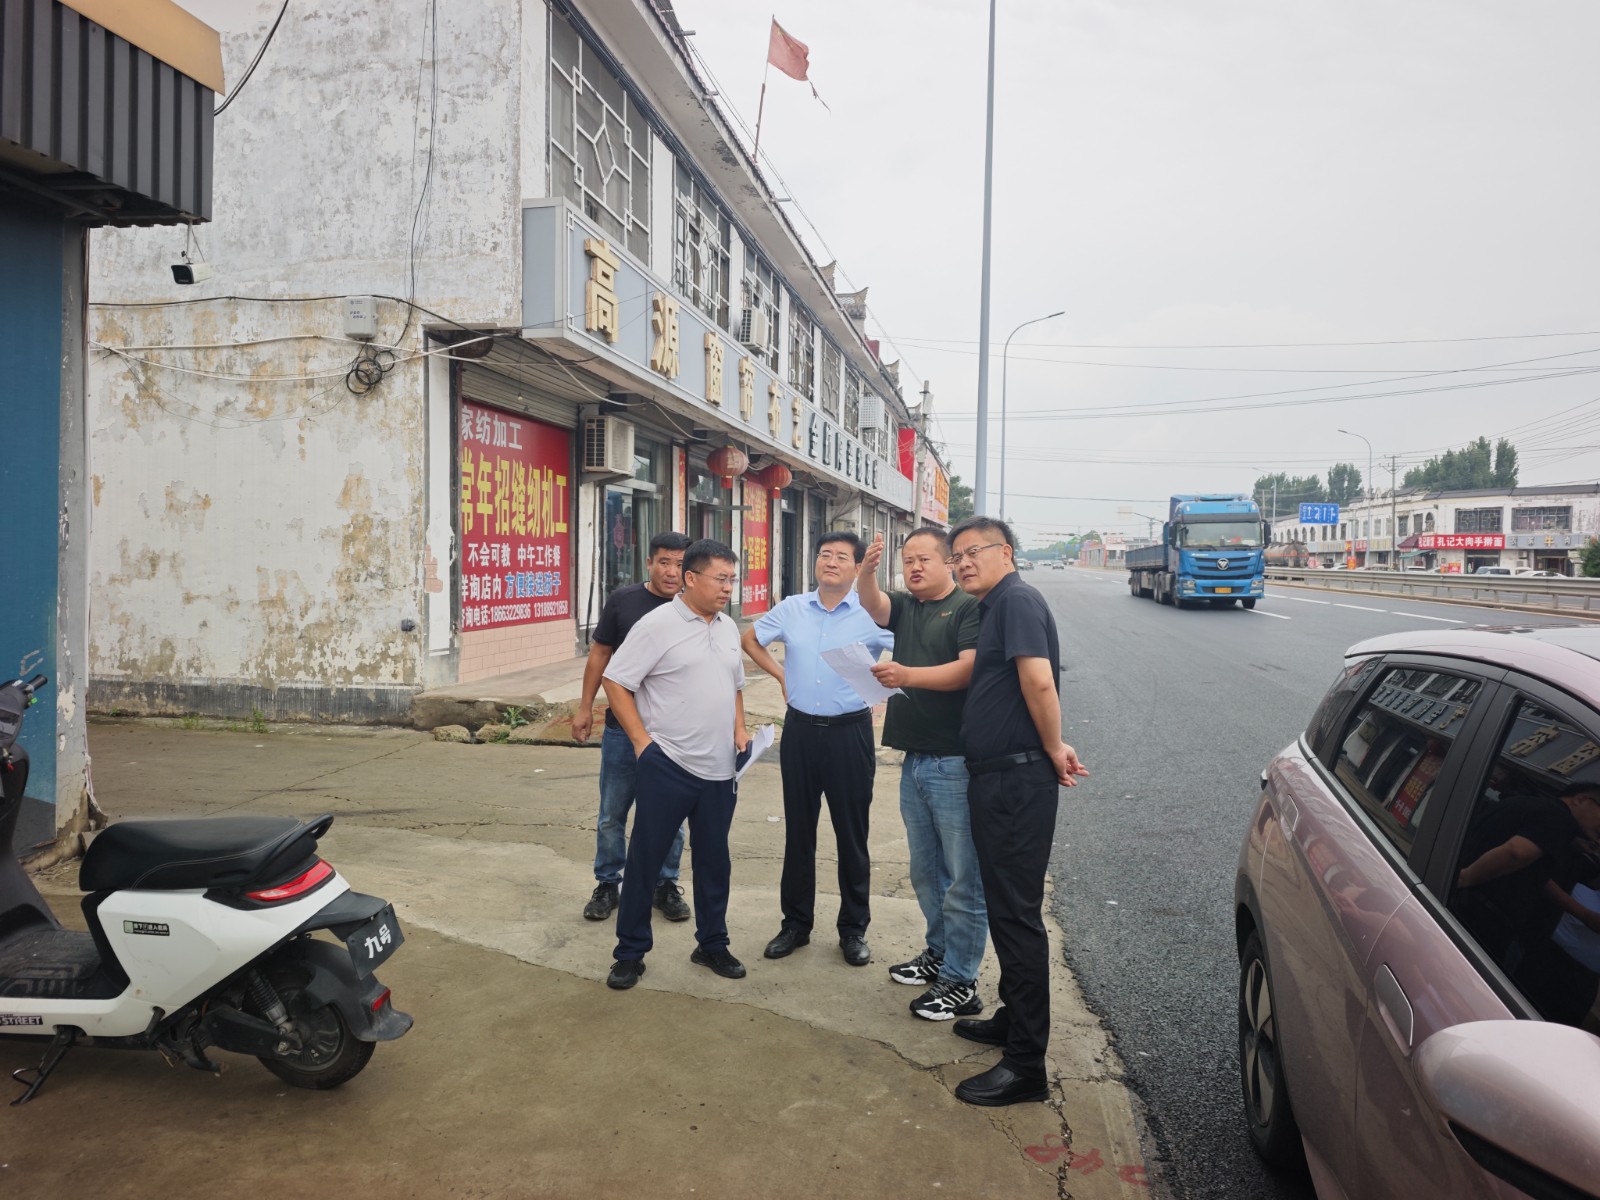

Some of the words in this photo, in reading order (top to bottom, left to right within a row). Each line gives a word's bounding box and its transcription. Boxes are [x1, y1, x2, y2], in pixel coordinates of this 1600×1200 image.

[584, 238, 803, 449] 高源窗帘布艺
[461, 405, 522, 450] 家纺加工
[461, 446, 567, 539] 常年招缝纫机工
[468, 542, 511, 567] 不会可教
[517, 543, 560, 567] 中午工作餐
[504, 570, 561, 599] 方便接送孩子
[364, 923, 392, 959] 九号
